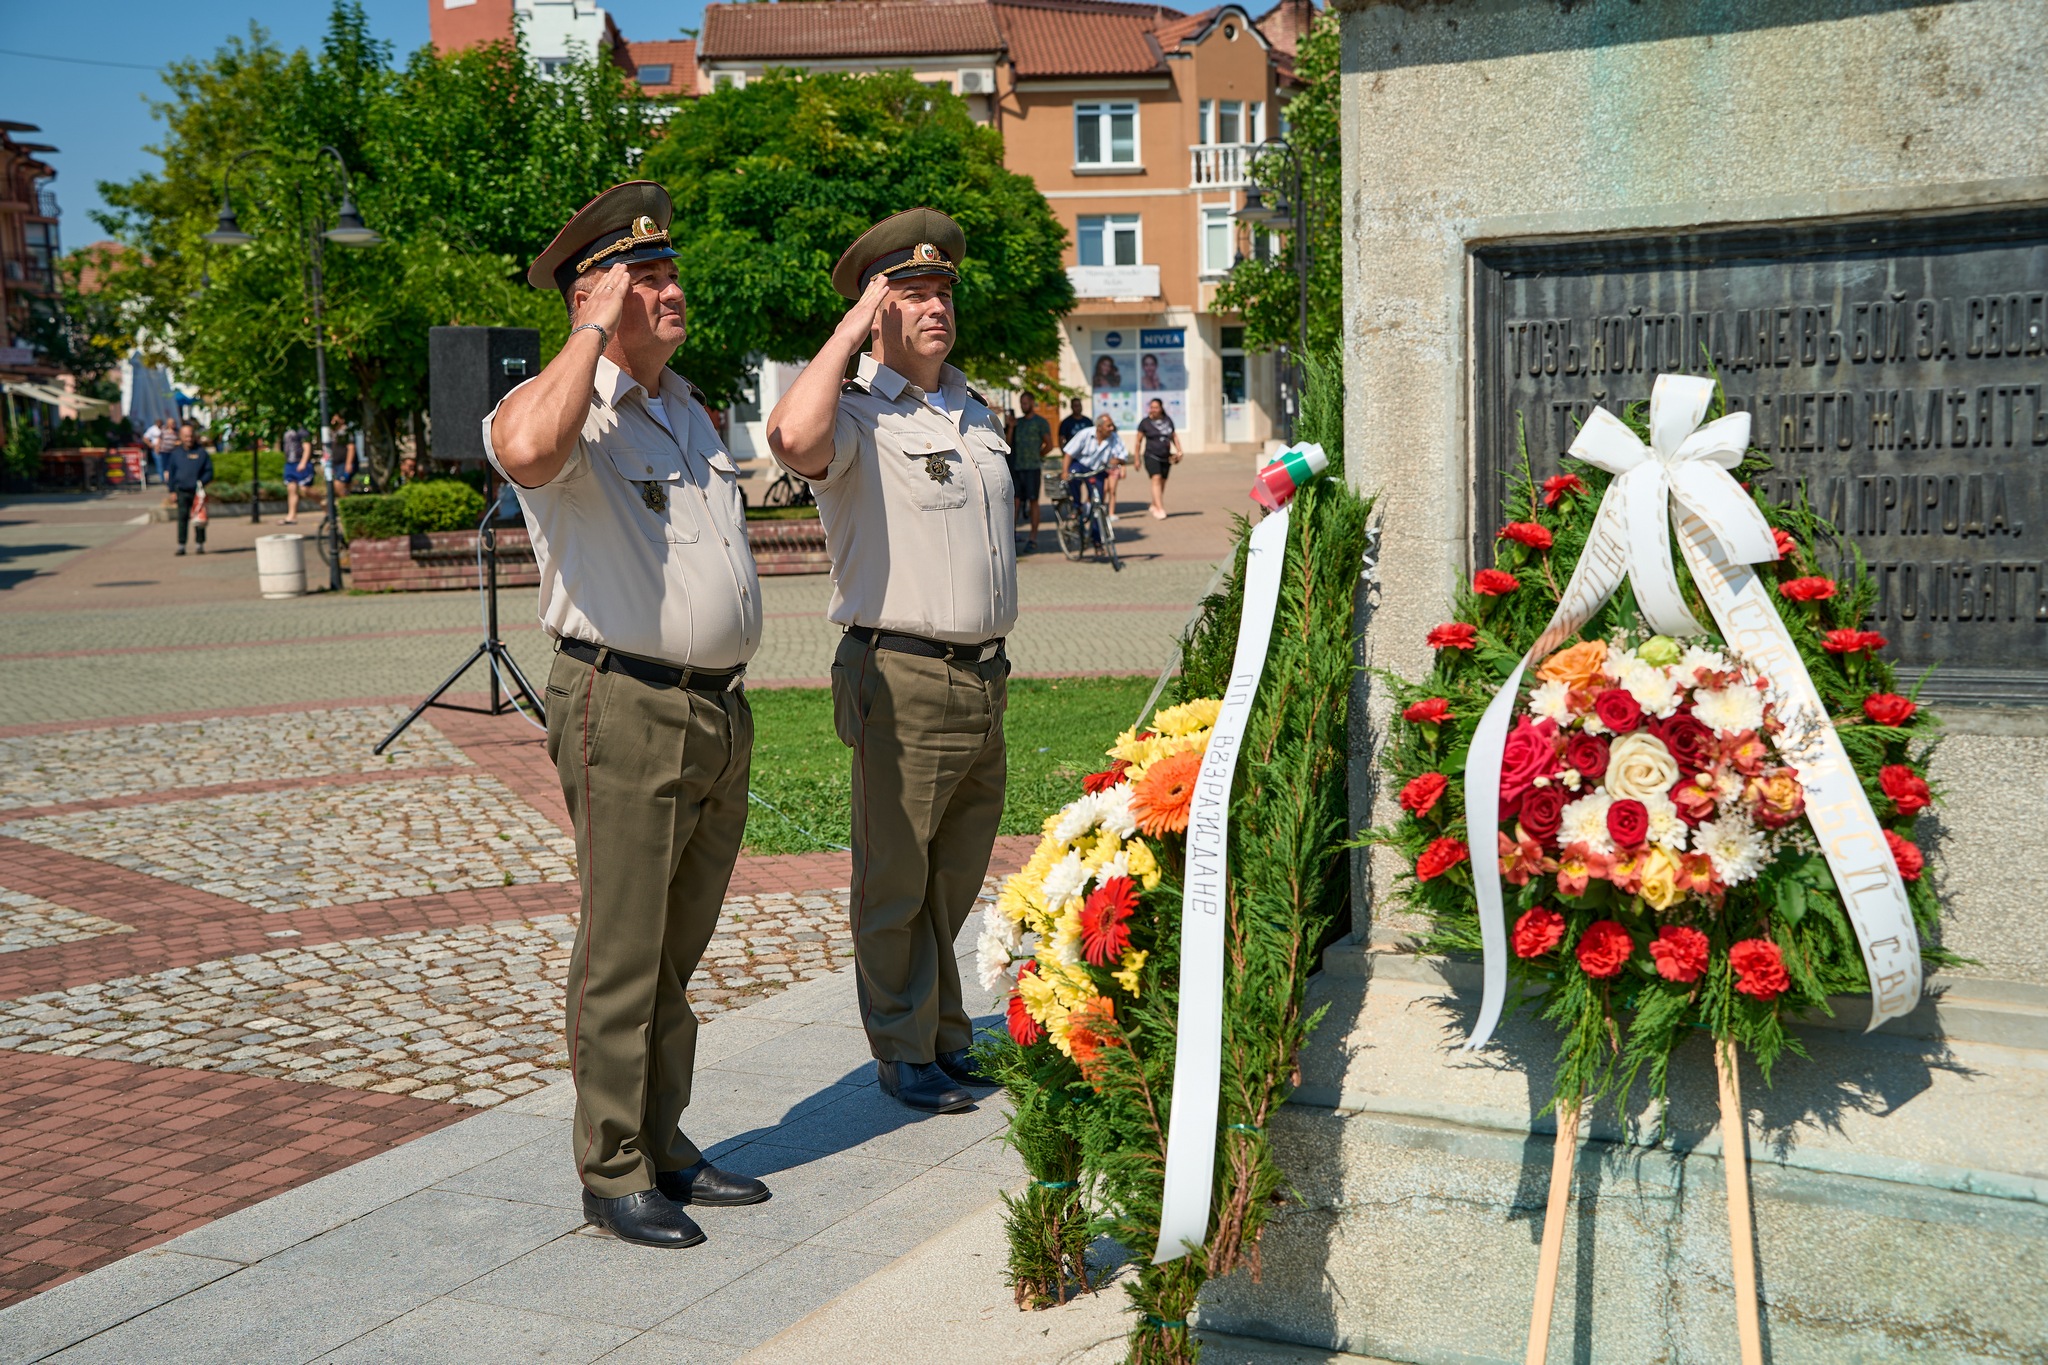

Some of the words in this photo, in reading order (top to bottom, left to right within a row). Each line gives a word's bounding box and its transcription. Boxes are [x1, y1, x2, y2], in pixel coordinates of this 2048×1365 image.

[1143, 333, 1181, 345] NIVEA
[1508, 318, 1588, 378] ТОЗЪ,
[1590, 304, 1682, 374] КОЙТО
[1690, 306, 1791, 374] ПАДНЕ
[1800, 303, 1843, 368] ВЪ
[1851, 289, 1906, 364] БОЙ
[1916, 297, 1956, 361] ЗА
[1966, 291, 2048, 360] СВОБ
[1779, 389, 1854, 453] НЕГО
[1856, 473, 2023, 539] ПРИРОДА,
[1227, 674, 1254, 706] ПП
